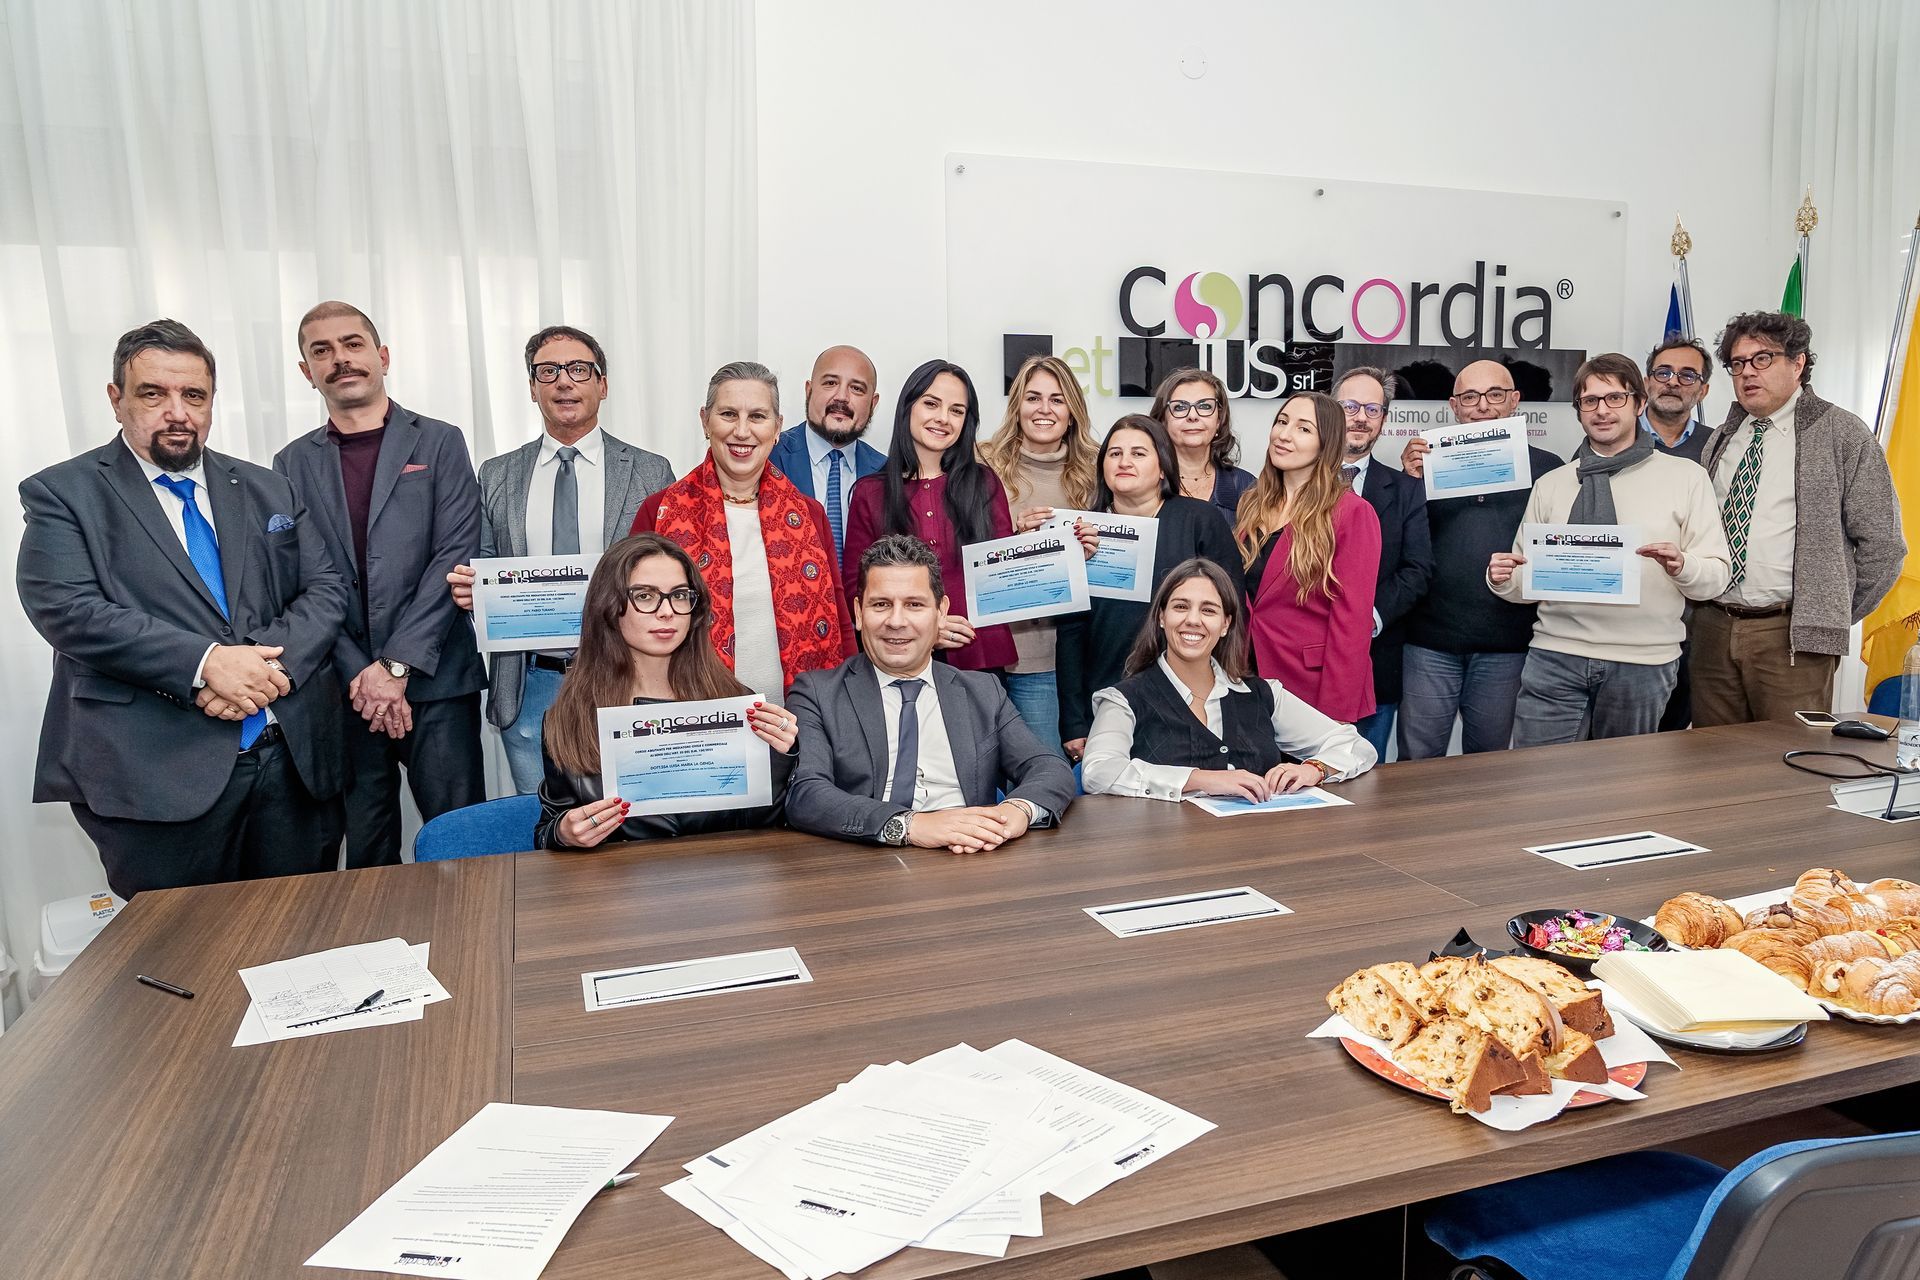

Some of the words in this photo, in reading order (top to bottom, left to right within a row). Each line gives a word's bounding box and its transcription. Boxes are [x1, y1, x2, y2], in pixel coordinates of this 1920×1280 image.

[1062, 336, 1112, 397] et
[1292, 370, 1314, 390] srl
[1436, 406, 1448, 423] di
[1440, 427, 1507, 442] concordia
[1545, 533, 1619, 543] concordia
[987, 539, 1060, 559] concordia
[497, 565, 584, 578] concordia
[632, 711, 738, 730] concordia
[621, 729, 633, 739] et
